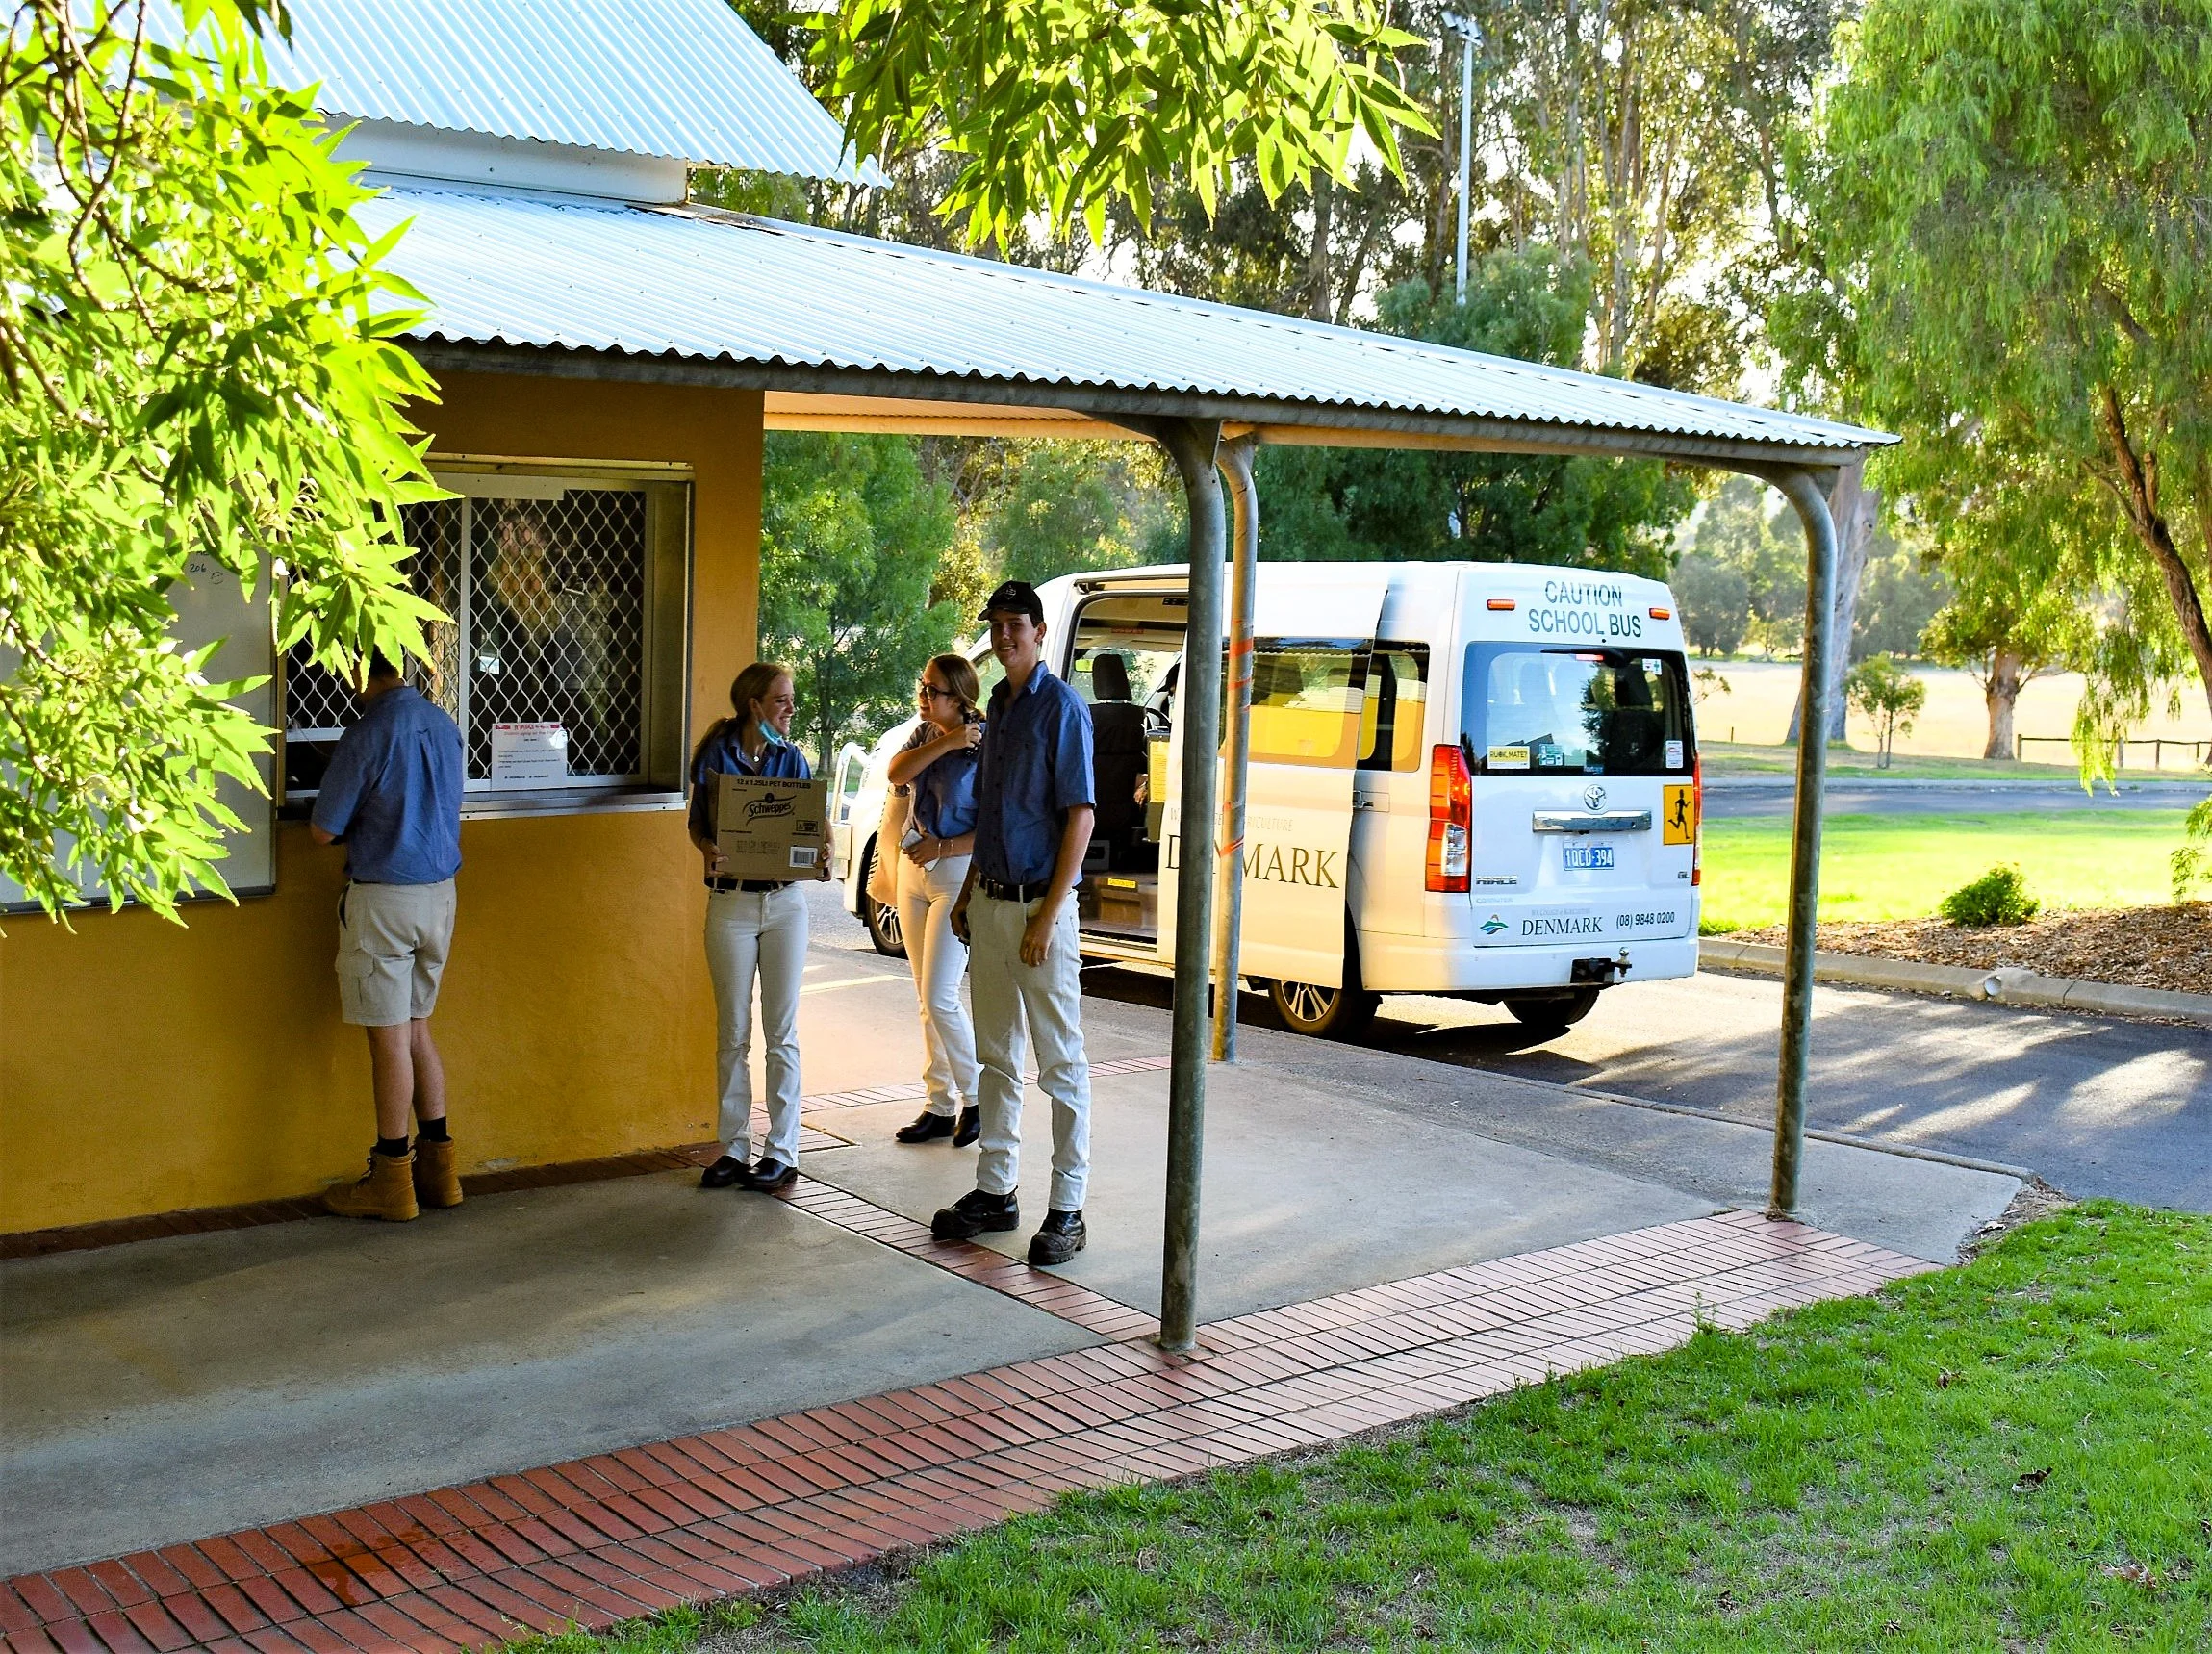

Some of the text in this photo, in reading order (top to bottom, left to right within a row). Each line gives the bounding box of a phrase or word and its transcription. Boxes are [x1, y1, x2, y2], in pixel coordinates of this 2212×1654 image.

[190, 563, 207, 573] 206
[1545, 580, 1622, 608] CAUTION
[1528, 608, 1641, 638] SCHOOL BUS
[748, 802, 792, 818] Schweppes
[1165, 834, 1340, 889] DMARK
[1677, 871, 1691, 879] GL
[1521, 911, 1675, 936] DENMARK (08) 9848 0200
